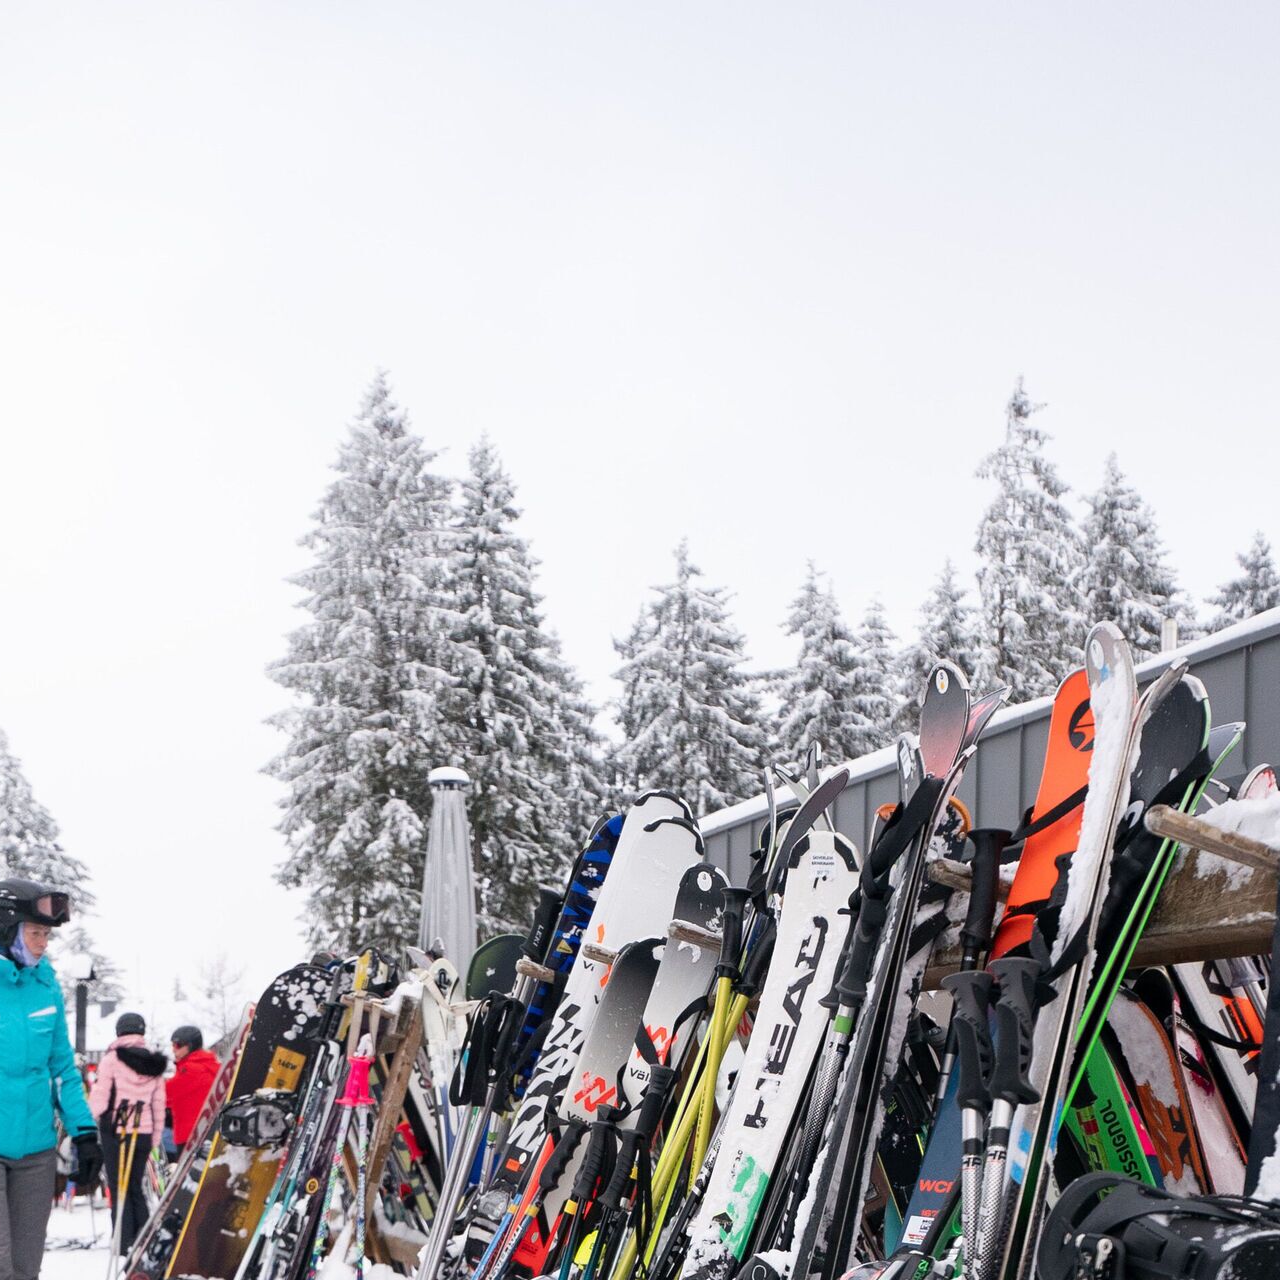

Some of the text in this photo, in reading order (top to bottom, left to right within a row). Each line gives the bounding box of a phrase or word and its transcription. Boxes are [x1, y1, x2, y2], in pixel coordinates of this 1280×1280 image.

[533, 925, 545, 948] LEKI
[742, 915, 829, 1129] HEAD
[630, 1067, 651, 1082] Völ
